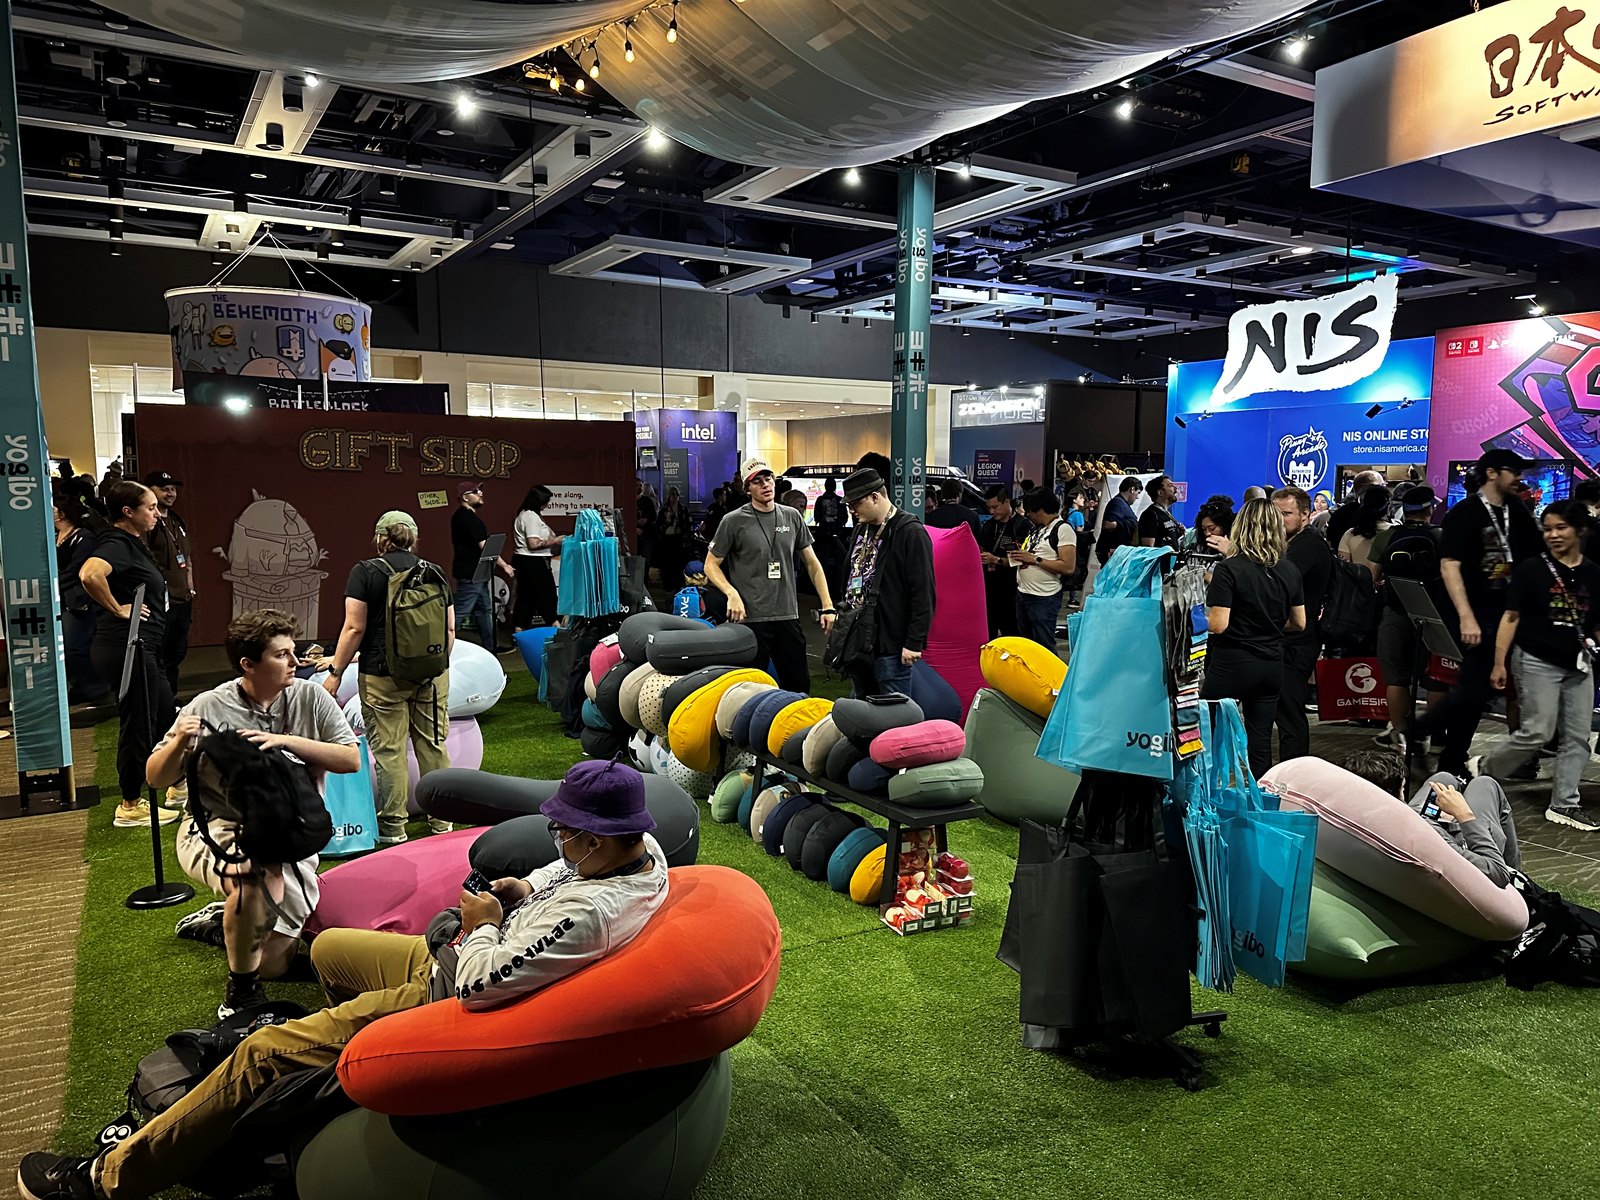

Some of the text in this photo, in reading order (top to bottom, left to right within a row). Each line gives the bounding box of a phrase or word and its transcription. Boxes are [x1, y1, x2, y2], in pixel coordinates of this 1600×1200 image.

[1485, 6, 1600, 98] 日本
[912, 227, 928, 282] yogibo
[212, 294, 228, 302] THE
[213, 303, 318, 324] BEHEMOTH
[1223, 295, 1380, 394] NIS
[910, 331, 926, 410] ヨギボー
[301, 429, 520, 477] GIFT SHOP
[1342, 431, 1362, 442] NIS
[1364, 429, 1408, 441] ONLINE
[0, 435, 38, 511] yogibo
[909, 457, 924, 507] yogibo
[1291, 473, 1311, 484] PIN
[547, 502, 569, 511] othing
[570, 502, 578, 510] to
[680, 596, 690, 618] PAX
[8, 578, 48, 690] ヨギボー
[1336, 697, 1388, 707] GAMESIR
[1126, 731, 1173, 758] yogi
